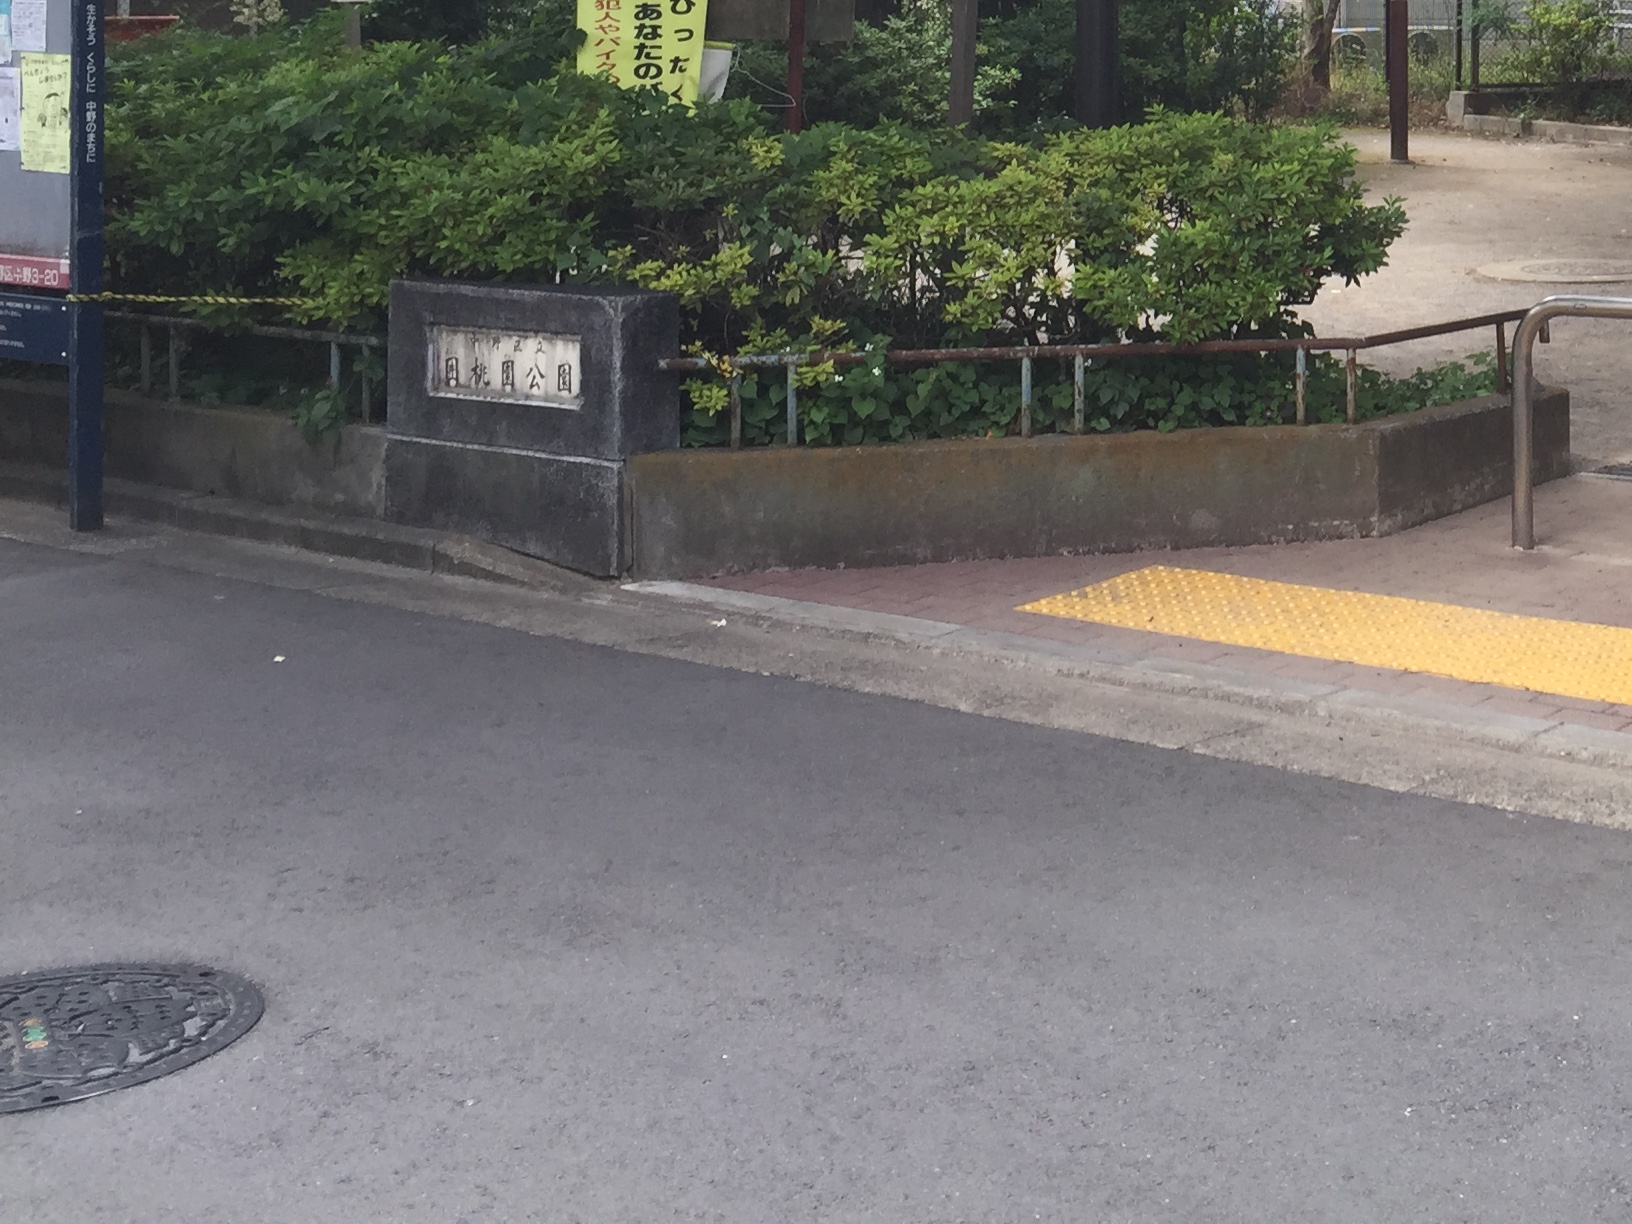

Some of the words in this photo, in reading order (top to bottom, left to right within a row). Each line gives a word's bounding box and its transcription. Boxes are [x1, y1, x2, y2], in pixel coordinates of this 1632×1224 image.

[85, 4, 97, 46] 生かそう
[85, 51, 97, 94] くらしに
[85, 100, 97, 164] 中野のまちに
